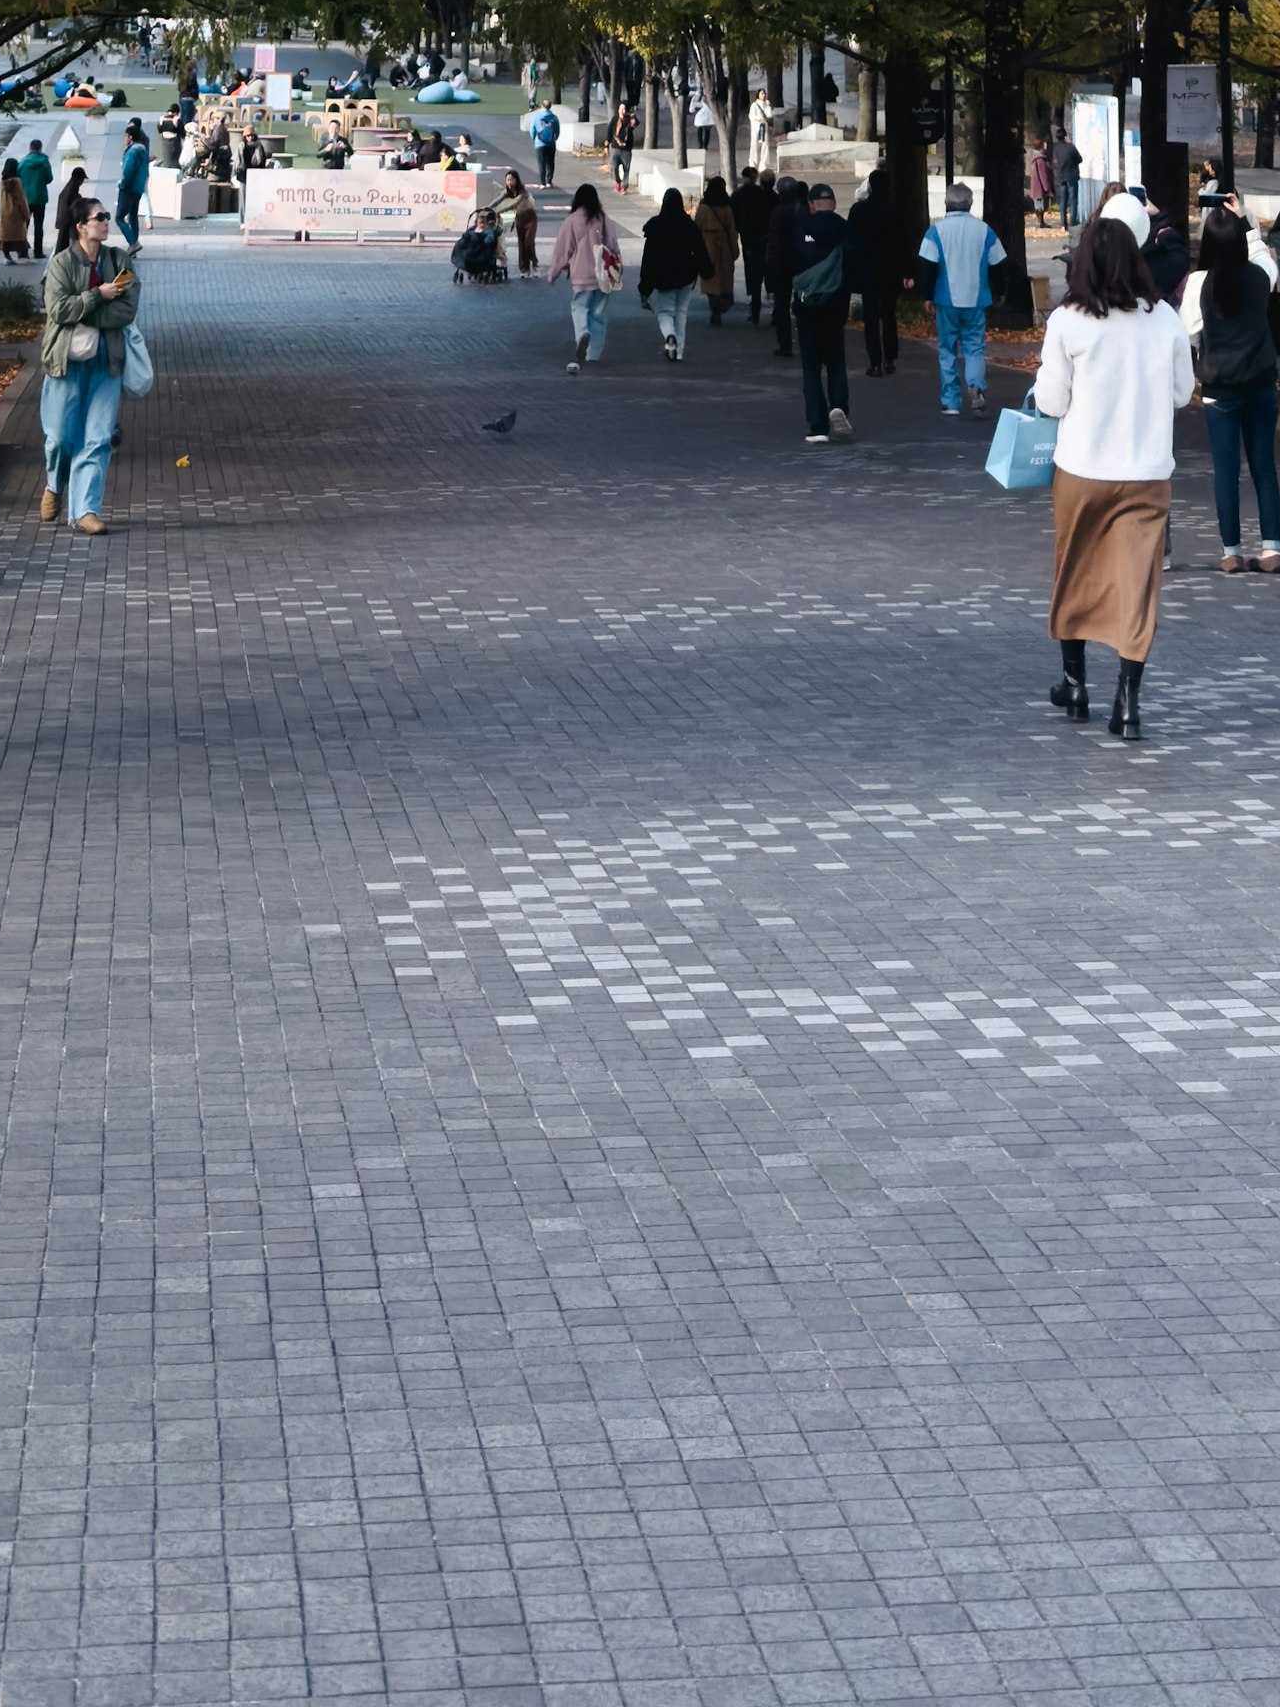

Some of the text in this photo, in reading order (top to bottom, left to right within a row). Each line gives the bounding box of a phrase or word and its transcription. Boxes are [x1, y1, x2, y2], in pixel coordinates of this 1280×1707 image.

[1172, 92, 1212, 100] MPY
[276, 188, 448, 207] MM Grass Park 2024
